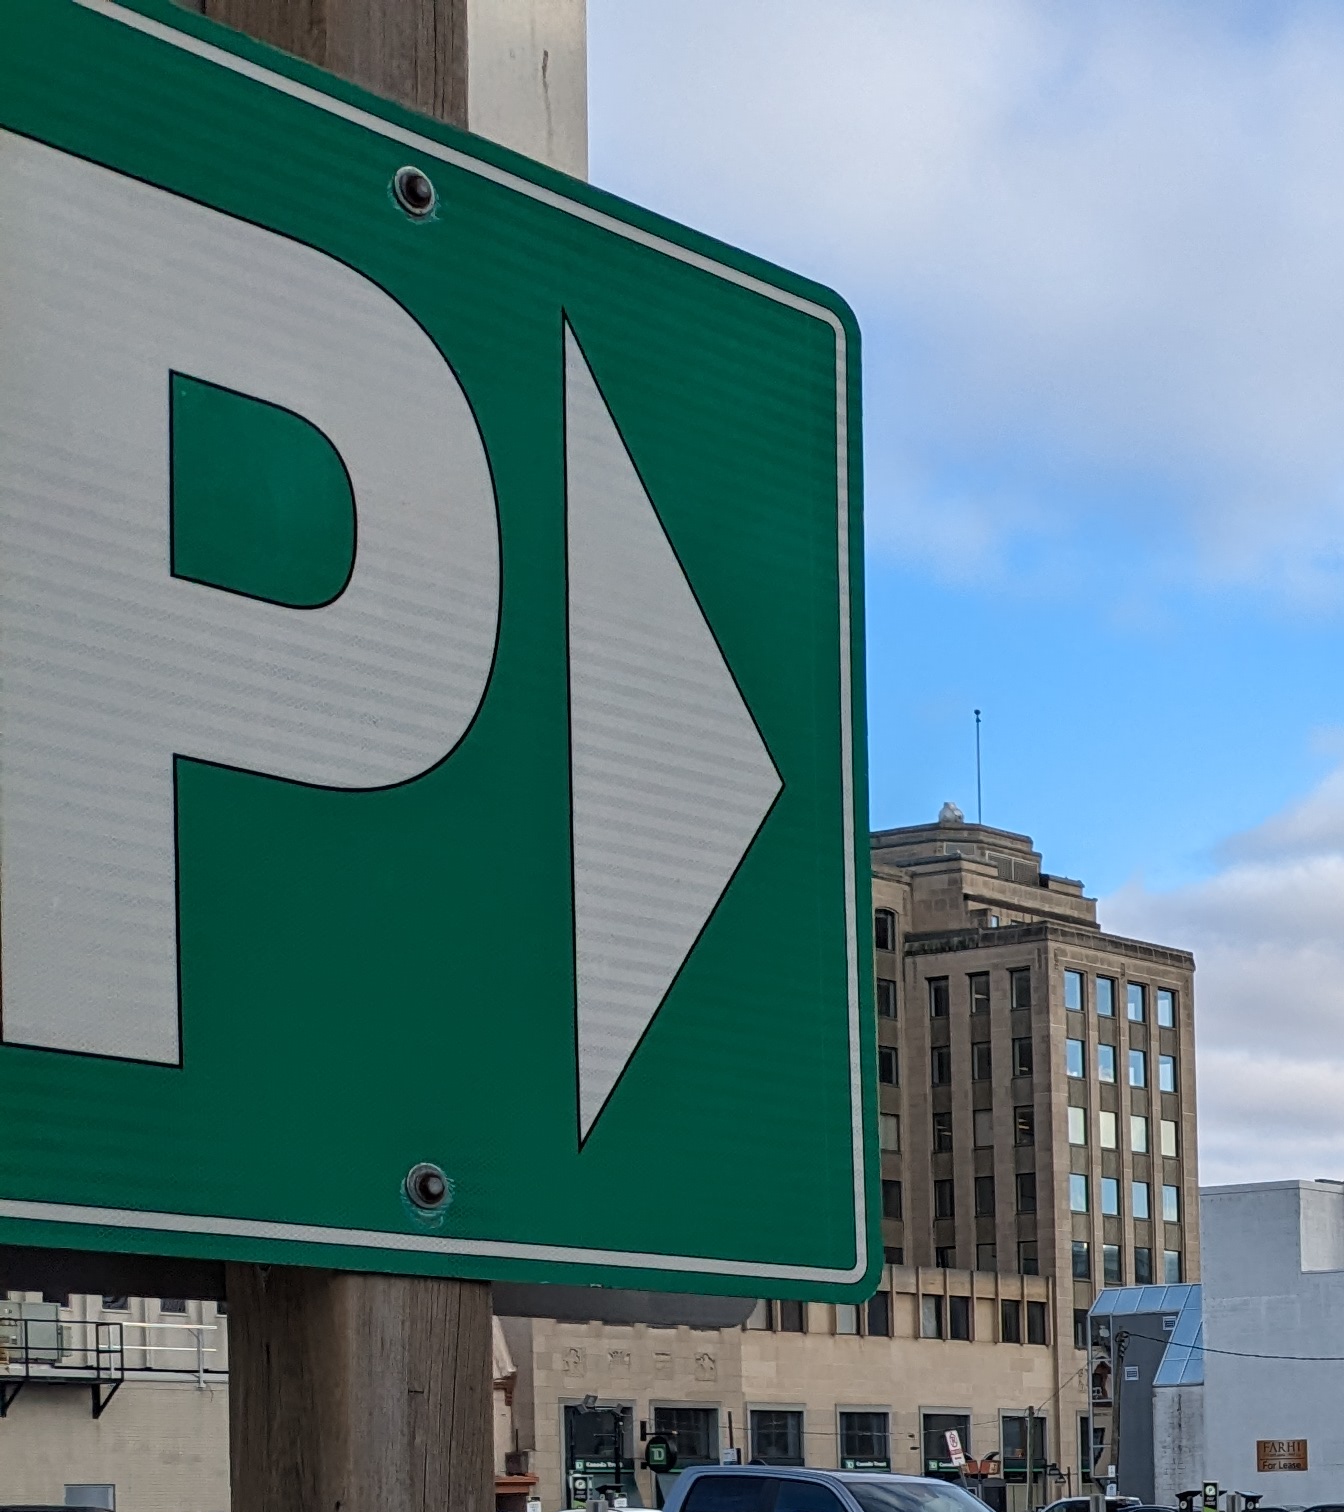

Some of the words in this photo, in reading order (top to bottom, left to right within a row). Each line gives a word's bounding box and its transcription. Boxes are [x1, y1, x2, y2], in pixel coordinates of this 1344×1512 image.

[0, 124, 503, 1069] P
[1263, 1441, 1301, 1453] FARHI
[651, 1447, 665, 1461] TD
[1262, 1460, 1277, 1470] For
[1278, 1460, 1302, 1470] Lease
